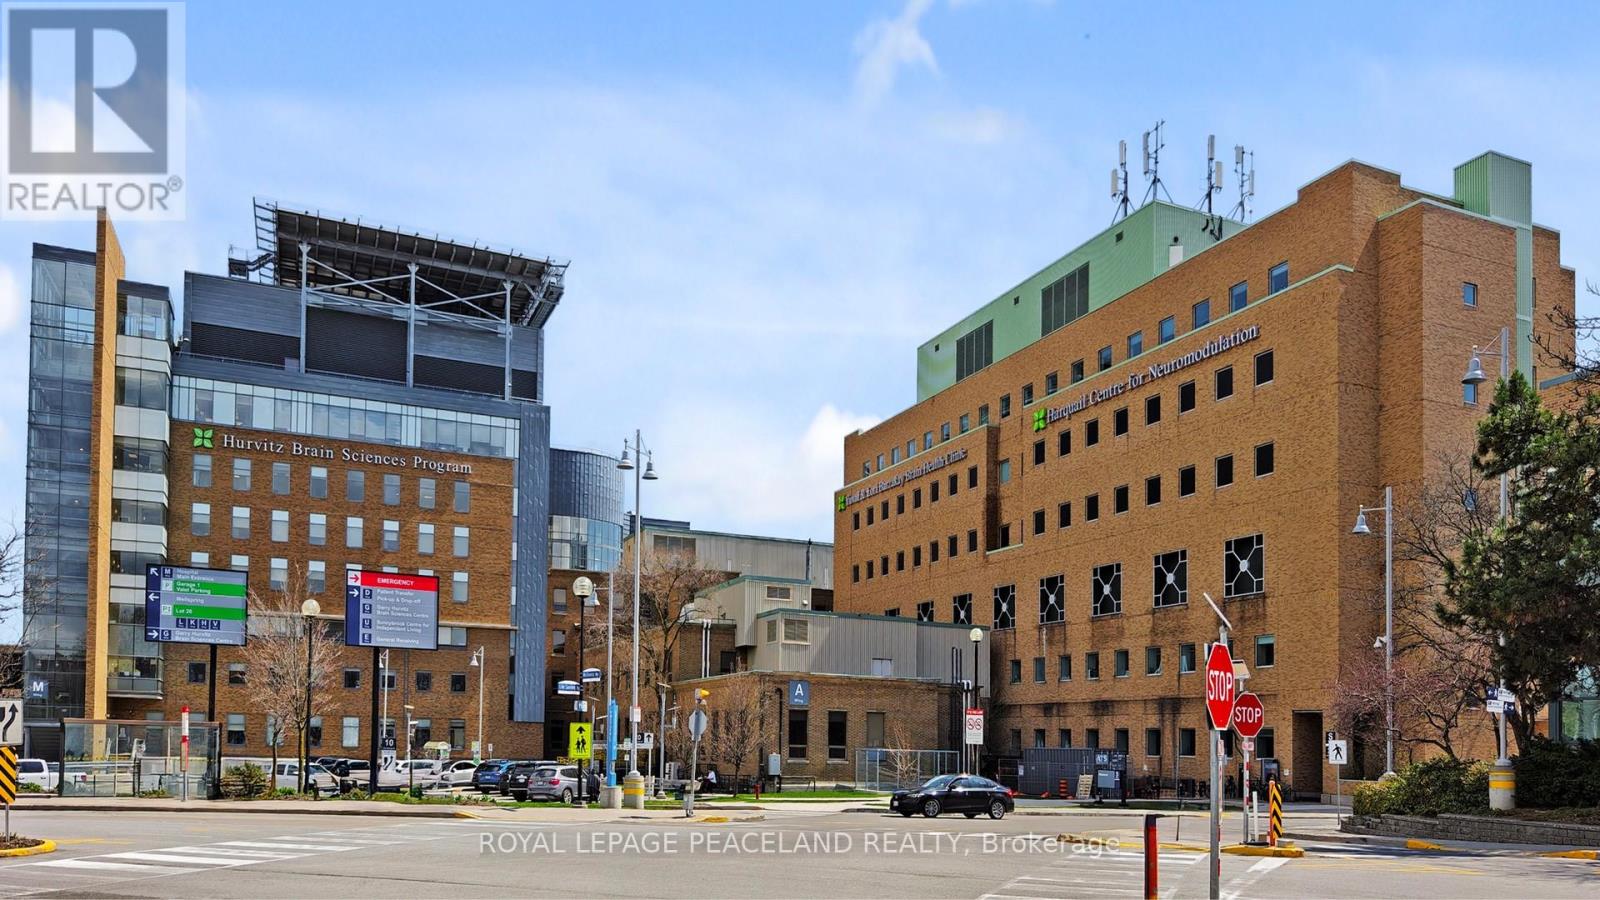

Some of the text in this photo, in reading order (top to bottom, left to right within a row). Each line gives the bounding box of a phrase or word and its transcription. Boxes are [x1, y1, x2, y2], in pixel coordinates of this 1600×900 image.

[1046, 324, 1259, 424] Harquail Centre for Neuromodulation
[222, 434, 473, 475] Hurvitz Brain Sciences Program
[377, 577, 414, 586] EMERGENCY
[33, 681, 44, 692] M
[794, 683, 804, 696] A
[1208, 669, 1233, 702] STOP
[1234, 706, 1262, 723] STOP
[384, 738, 394, 747] 10
